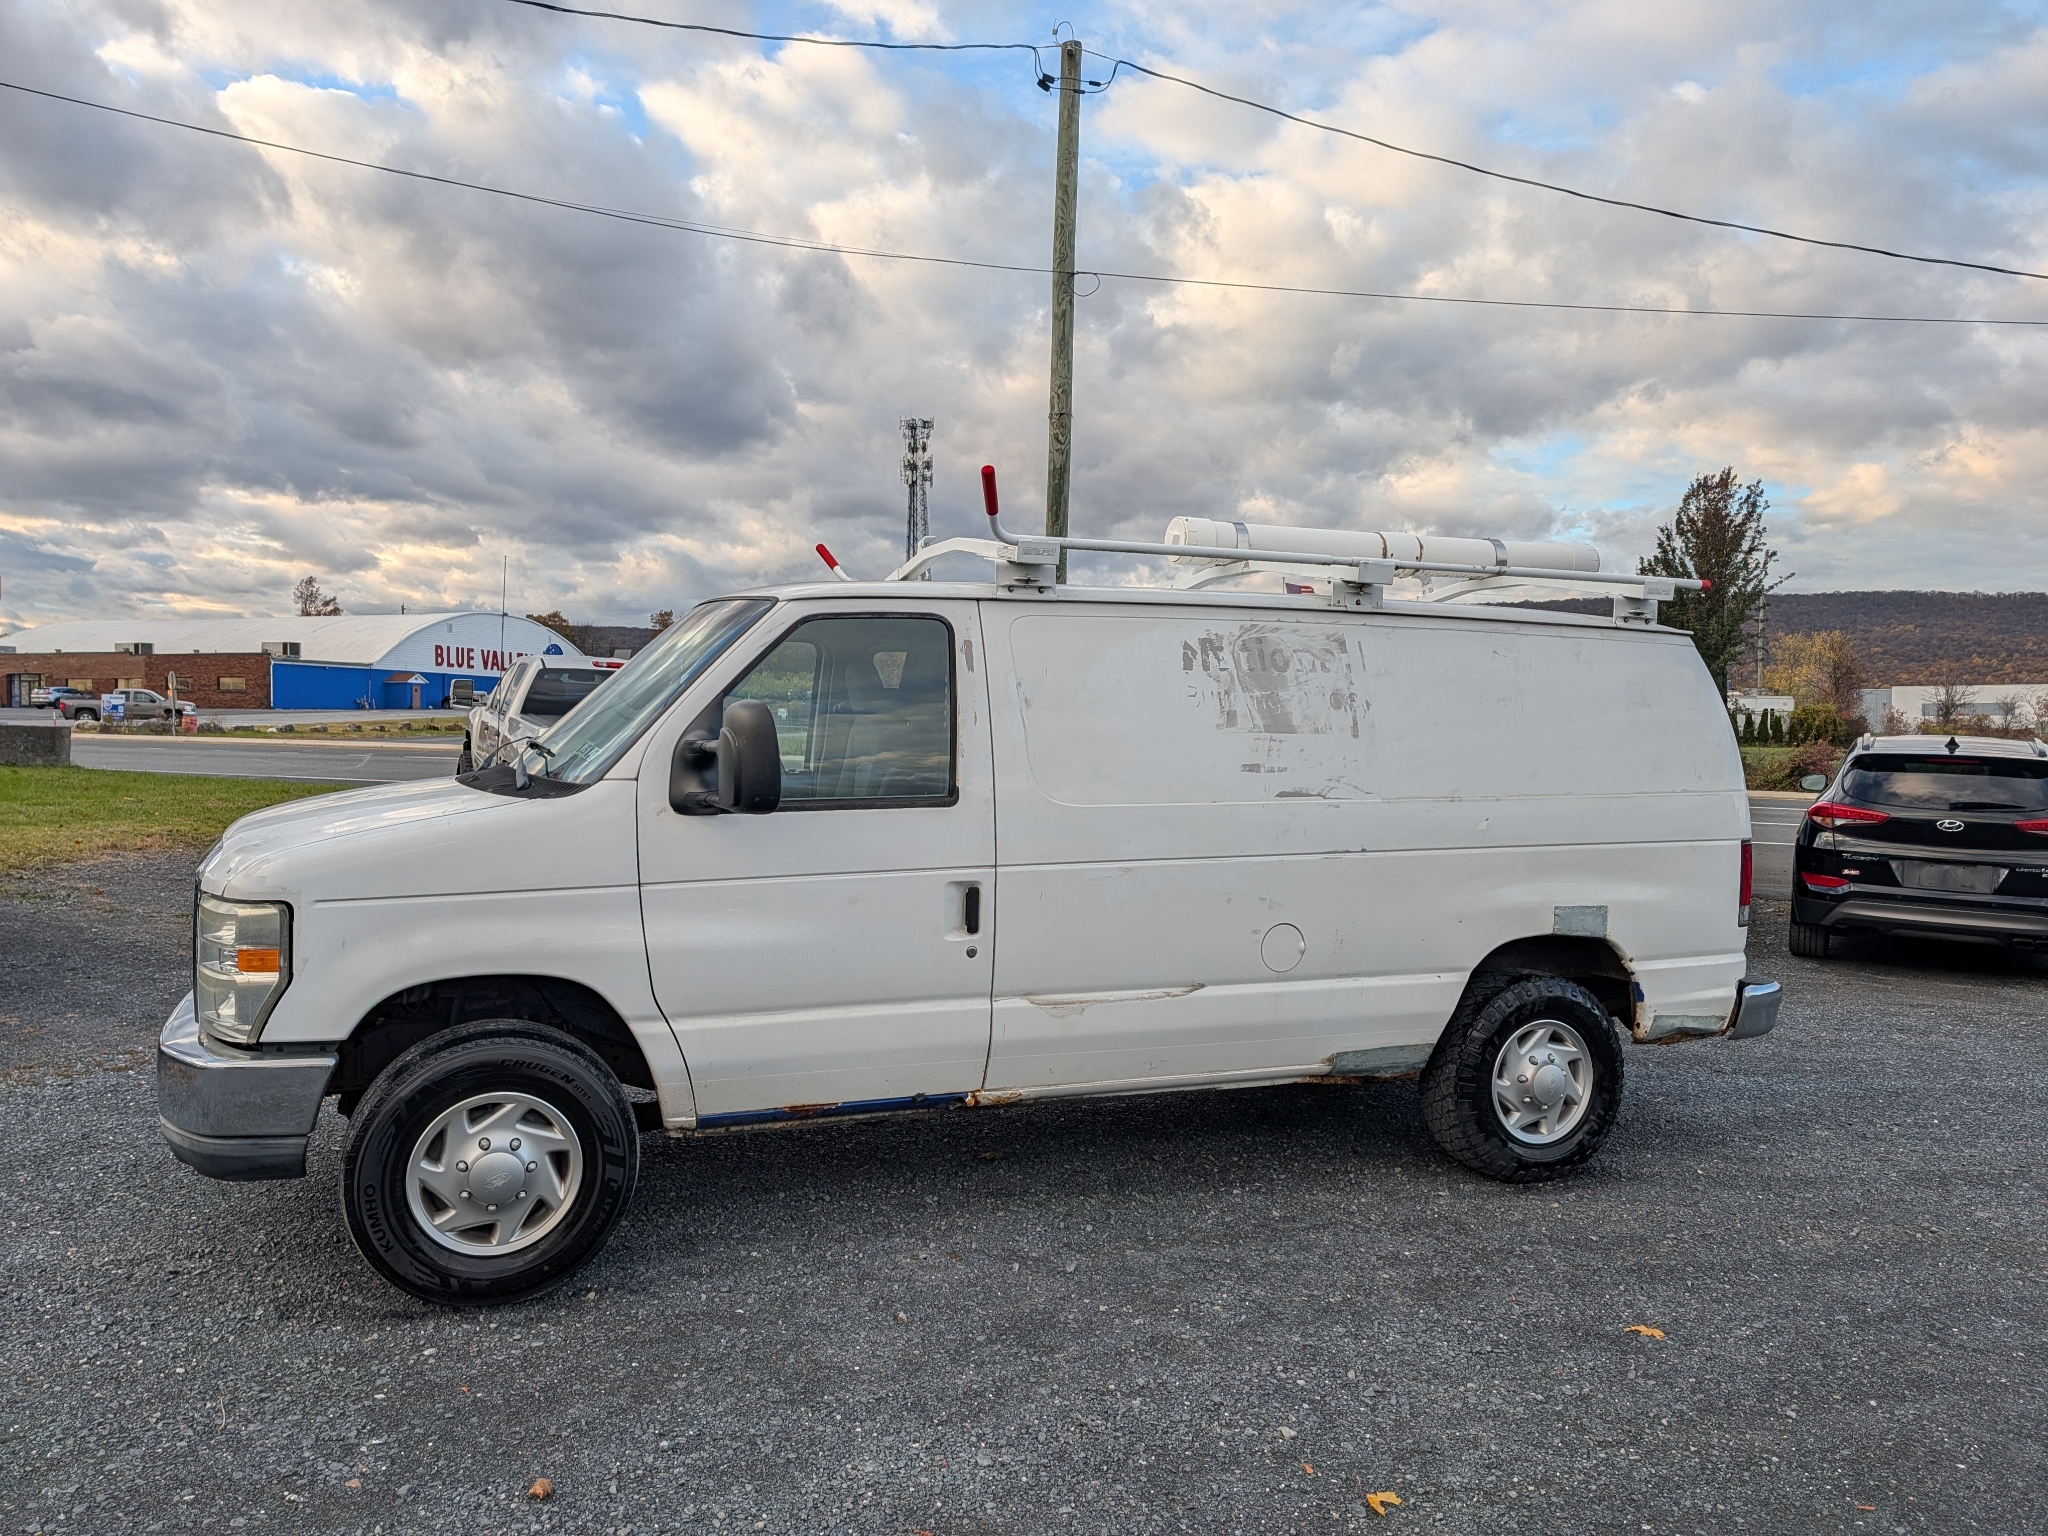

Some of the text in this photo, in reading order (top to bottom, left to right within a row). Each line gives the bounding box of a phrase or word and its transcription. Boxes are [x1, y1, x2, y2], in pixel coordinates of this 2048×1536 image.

[435, 645, 534, 671] BLUE VALL
[499, 1059, 576, 1084] CRUGEN
[364, 1183, 394, 1254] KUMHO
